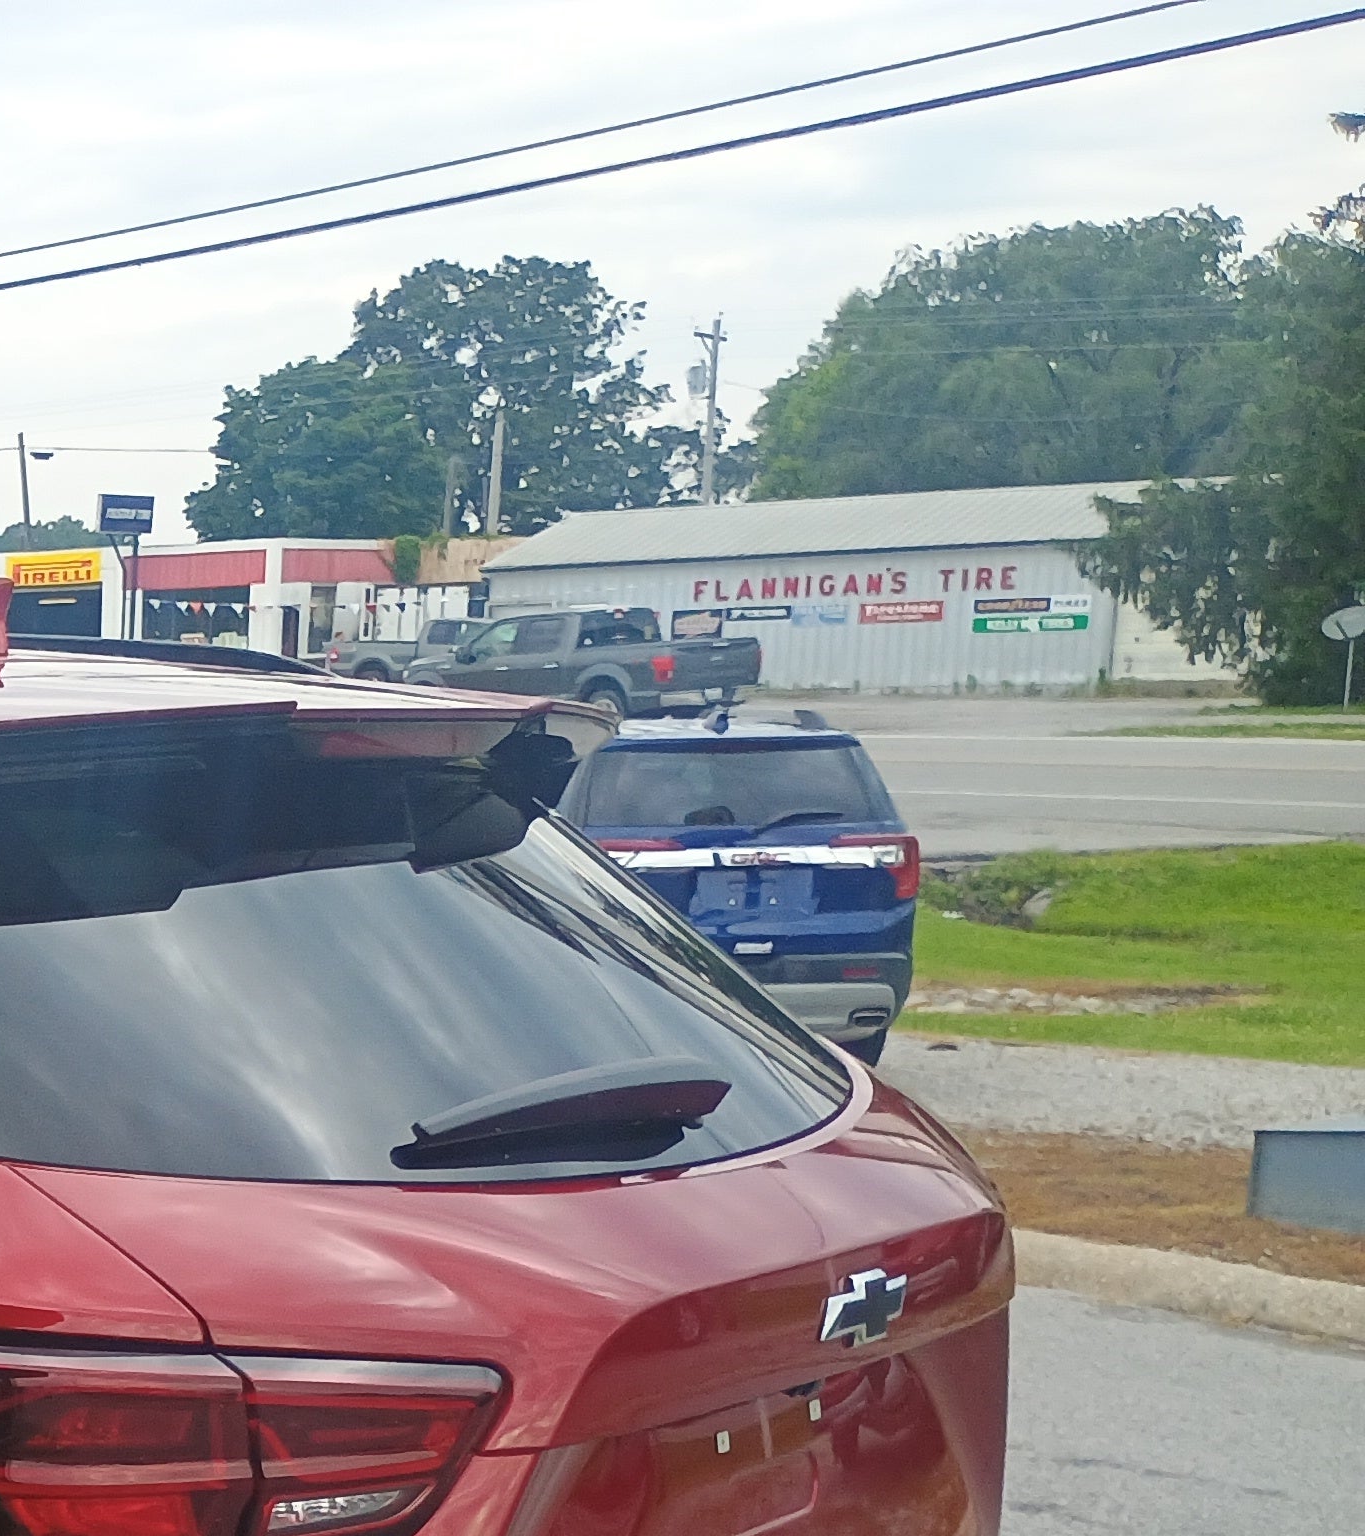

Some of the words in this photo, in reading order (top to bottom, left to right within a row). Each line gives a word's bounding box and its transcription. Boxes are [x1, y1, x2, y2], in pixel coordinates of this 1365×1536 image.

[13, 560, 92, 584] PIRELLI
[693, 568, 907, 602] FLANNIGAN'S
[938, 566, 1017, 592] TIRE
